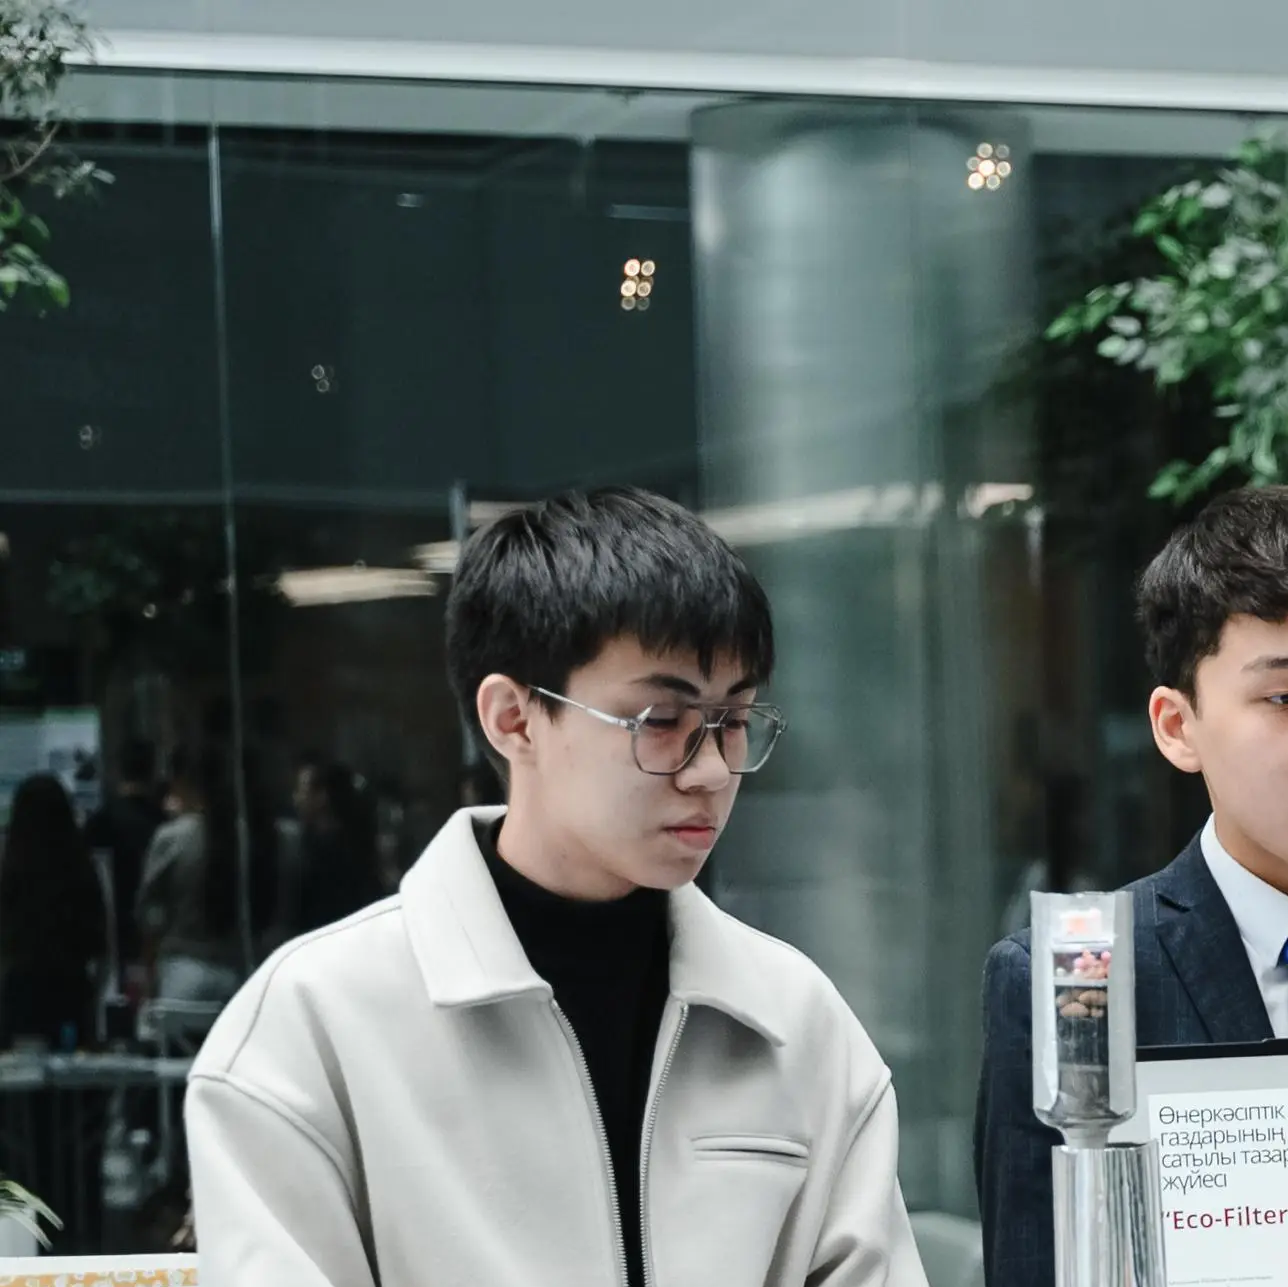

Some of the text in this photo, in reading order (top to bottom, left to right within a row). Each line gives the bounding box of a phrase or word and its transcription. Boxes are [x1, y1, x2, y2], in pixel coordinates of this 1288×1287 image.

[1158, 1104, 1286, 1129] Өнеркәсіптік
[1160, 1127, 1286, 1150] газдарының
[1161, 1149, 1236, 1168] сатылы
[1162, 1169, 1228, 1195] жүйесі
